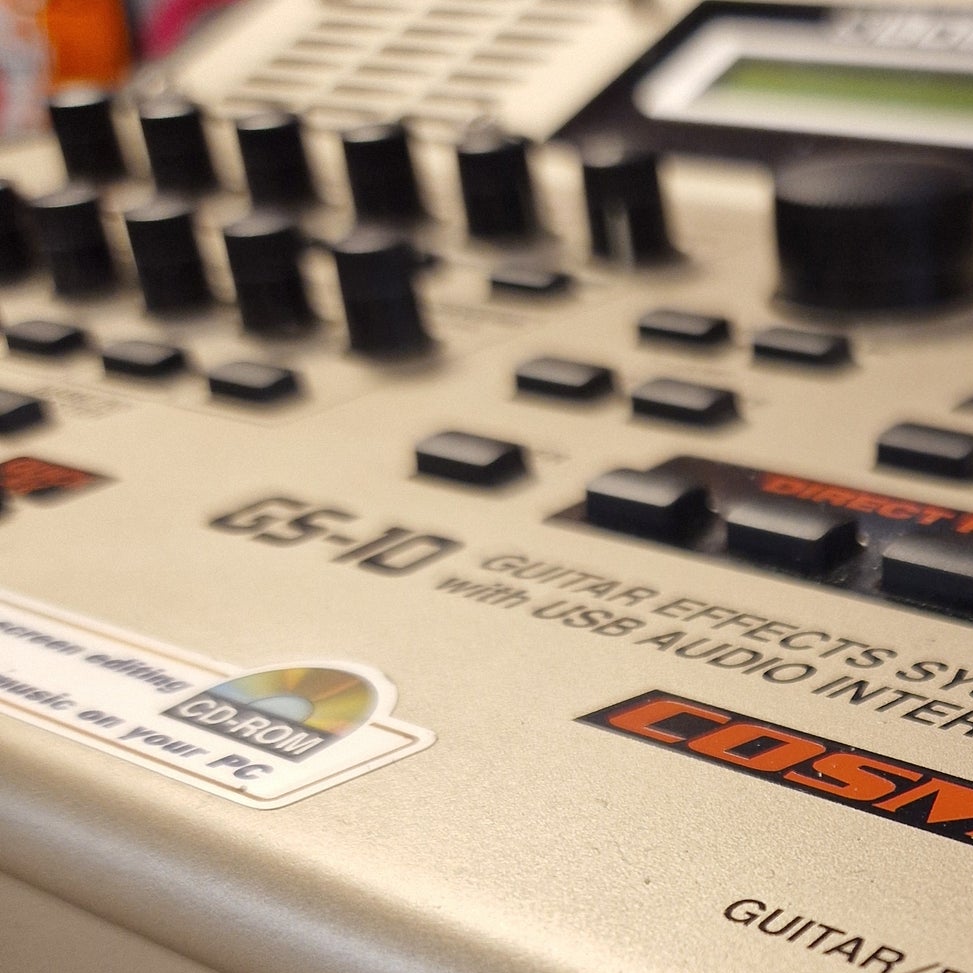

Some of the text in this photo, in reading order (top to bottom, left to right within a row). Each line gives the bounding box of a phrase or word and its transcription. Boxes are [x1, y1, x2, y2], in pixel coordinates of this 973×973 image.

[760, 472, 957, 526] DIRECT
[208, 497, 465, 578] GS-10
[435, 577, 531, 609] with
[532, 600, 647, 637] USB
[634, 630, 817, 684] AUDIO
[481, 555, 660, 606] GUITAR
[650, 598, 897, 669] EFFECTS
[85, 654, 193, 694] editing
[77, 710, 125, 728] on
[118, 726, 209, 757] your
[205, 753, 274, 781] PC
[178, 698, 326, 756] CD-ROM
